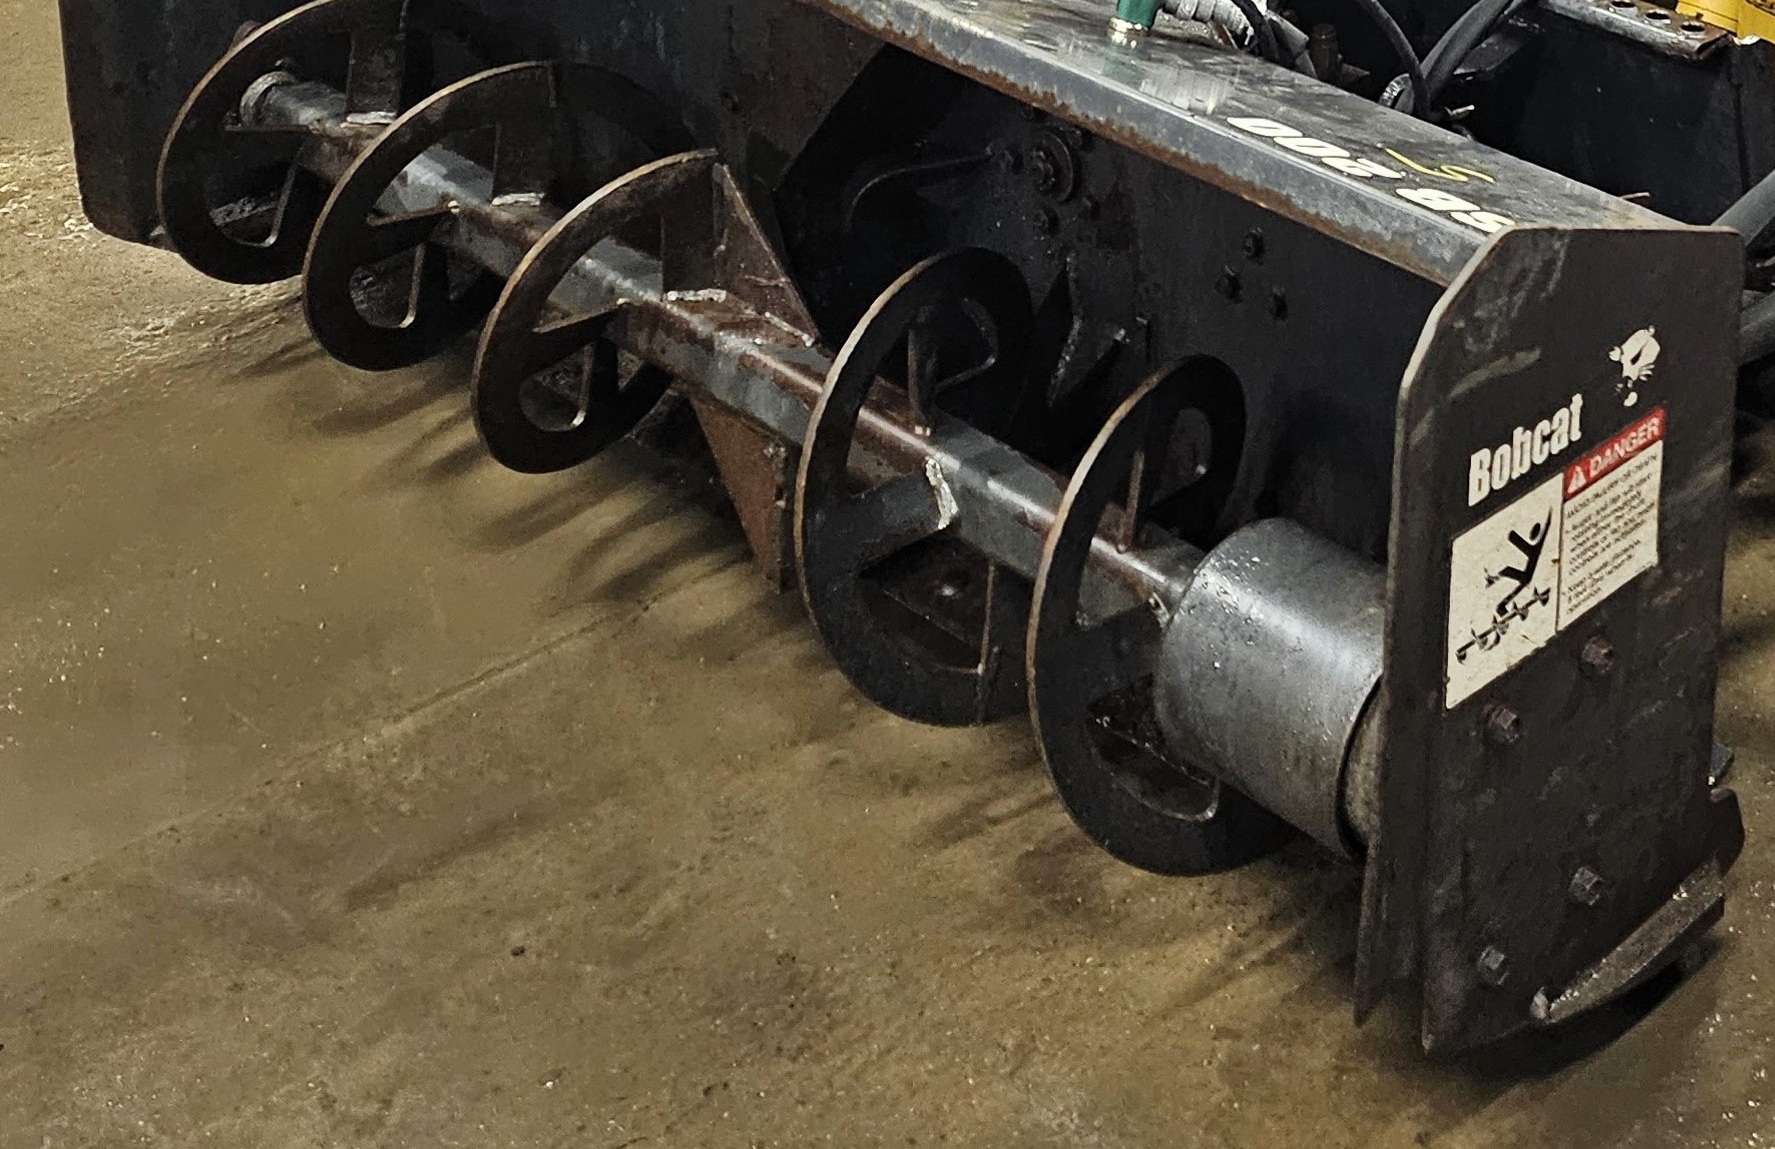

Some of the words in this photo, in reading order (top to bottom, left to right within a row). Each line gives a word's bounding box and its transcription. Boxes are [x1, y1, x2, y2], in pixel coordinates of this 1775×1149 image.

[1226, 116, 1403, 179] 200
[1468, 393, 1583, 507] Bobcat
[1589, 417, 1660, 478] DANGER
